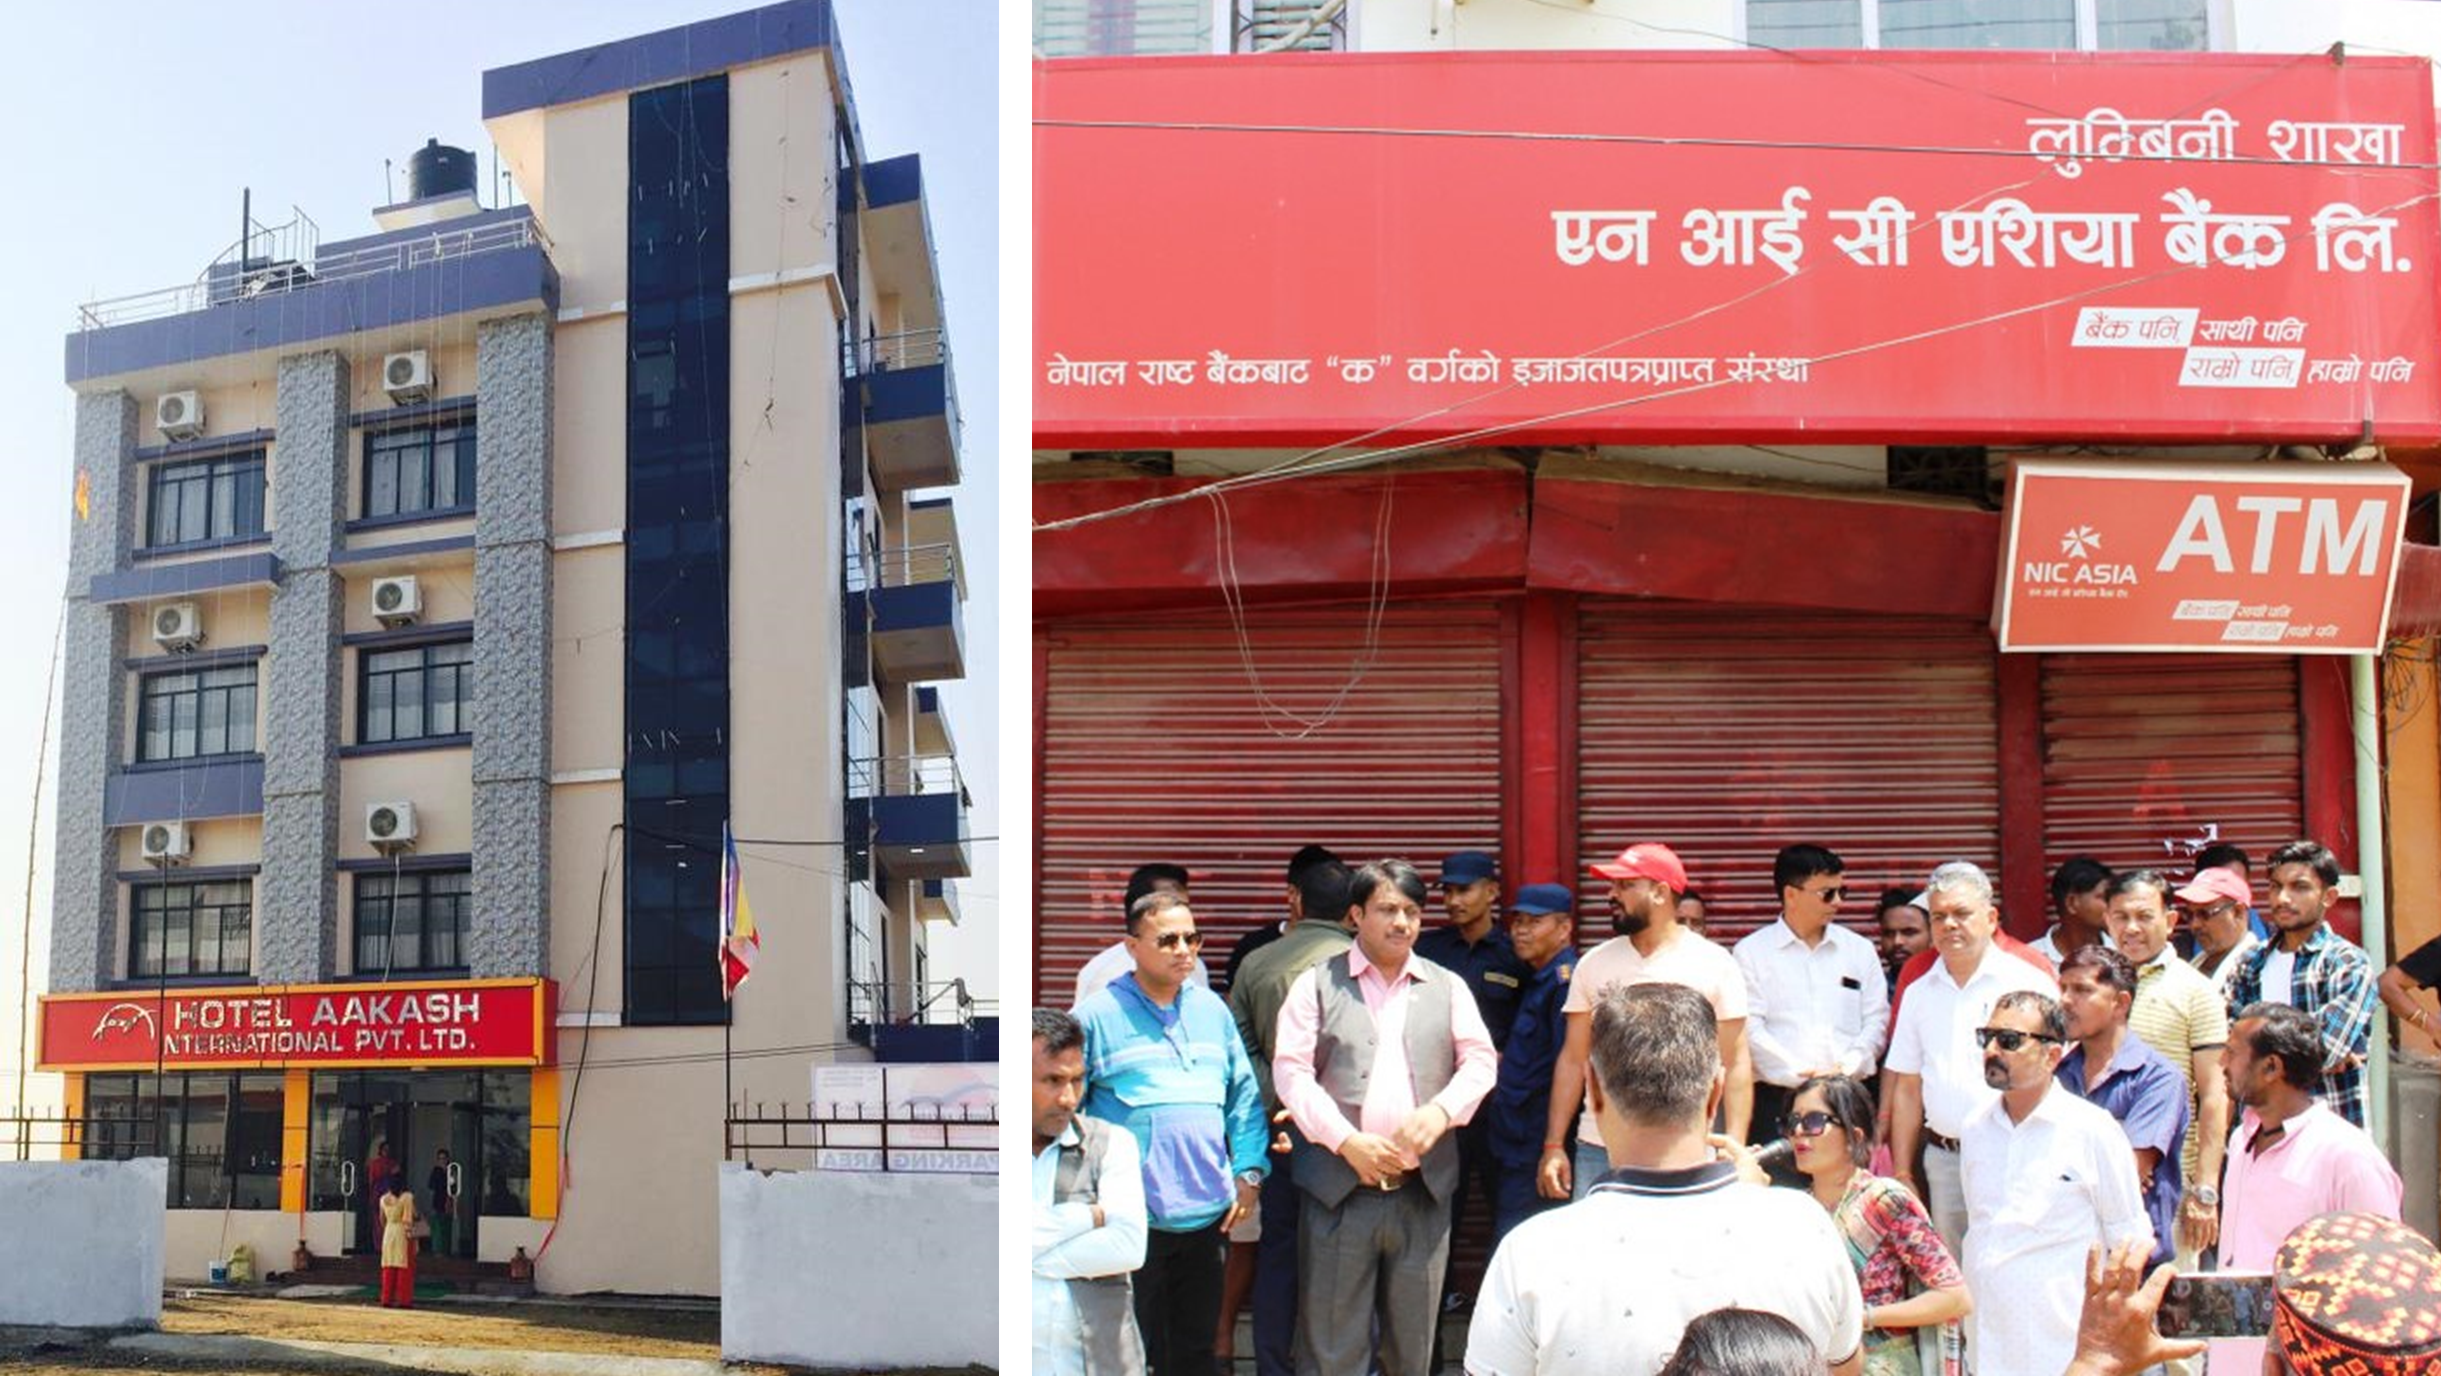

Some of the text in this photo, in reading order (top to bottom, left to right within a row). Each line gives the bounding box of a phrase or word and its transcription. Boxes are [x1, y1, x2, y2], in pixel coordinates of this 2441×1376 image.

[2267, 119, 2405, 165] शाखा
[1550, 186, 2412, 275] एन आई सी एशिया बैंक लि.
[2199, 316, 2258, 343] साथी
[2263, 317, 2308, 343] पनि
[1046, 352, 1128, 386] नेपाल
[1206, 350, 1312, 384] बैंकबाट
[1406, 348, 1501, 383] वर्गको
[1510, 356, 1716, 387] इजाजतपत्रप्राप्त
[1725, 351, 1812, 383] संस्था
[2369, 356, 2415, 384] पनि
[2155, 494, 2388, 576] ATM
[2023, 562, 2138, 585] NIC ASIA
[174, 993, 480, 1030] HOTEL AAKASH
[163, 1027, 476, 1055] NTERNATIONAL PVT. LTD.
